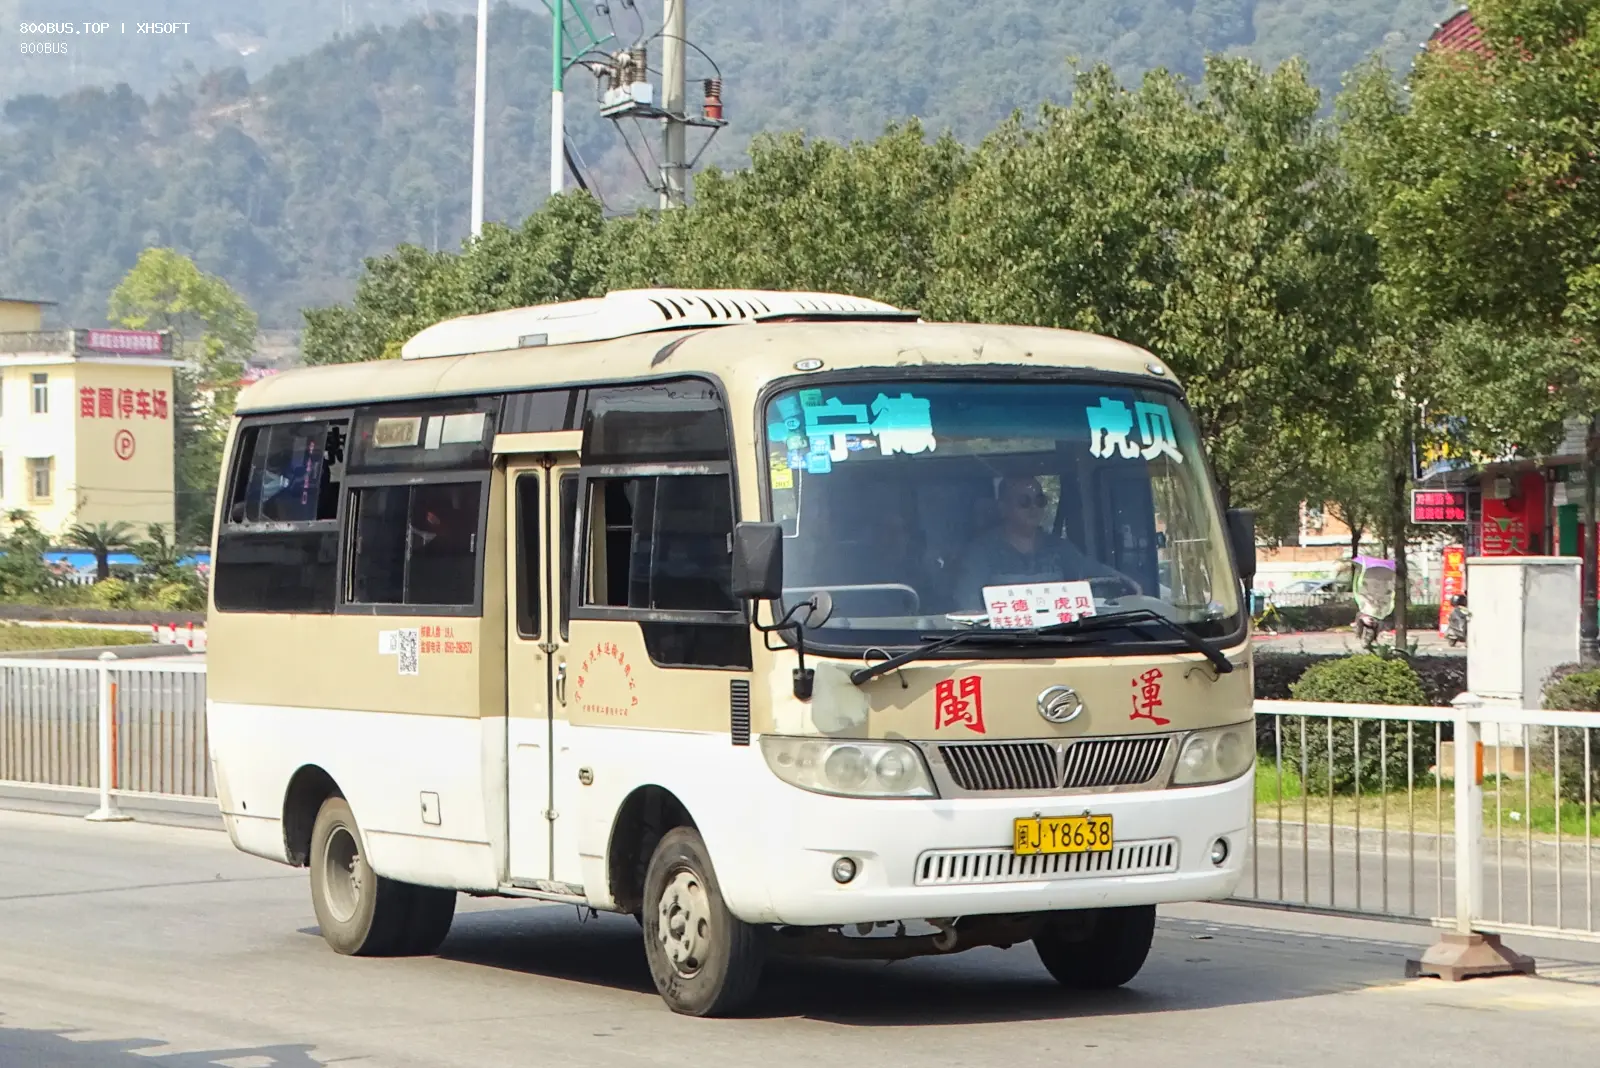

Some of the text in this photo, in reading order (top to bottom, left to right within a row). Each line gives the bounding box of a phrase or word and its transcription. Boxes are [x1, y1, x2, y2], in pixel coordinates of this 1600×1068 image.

[804, 392, 1184, 464] 宁德 虎贝
[990, 599, 1030, 614] 宁德
[1054, 596, 1090, 610] 虎贝
